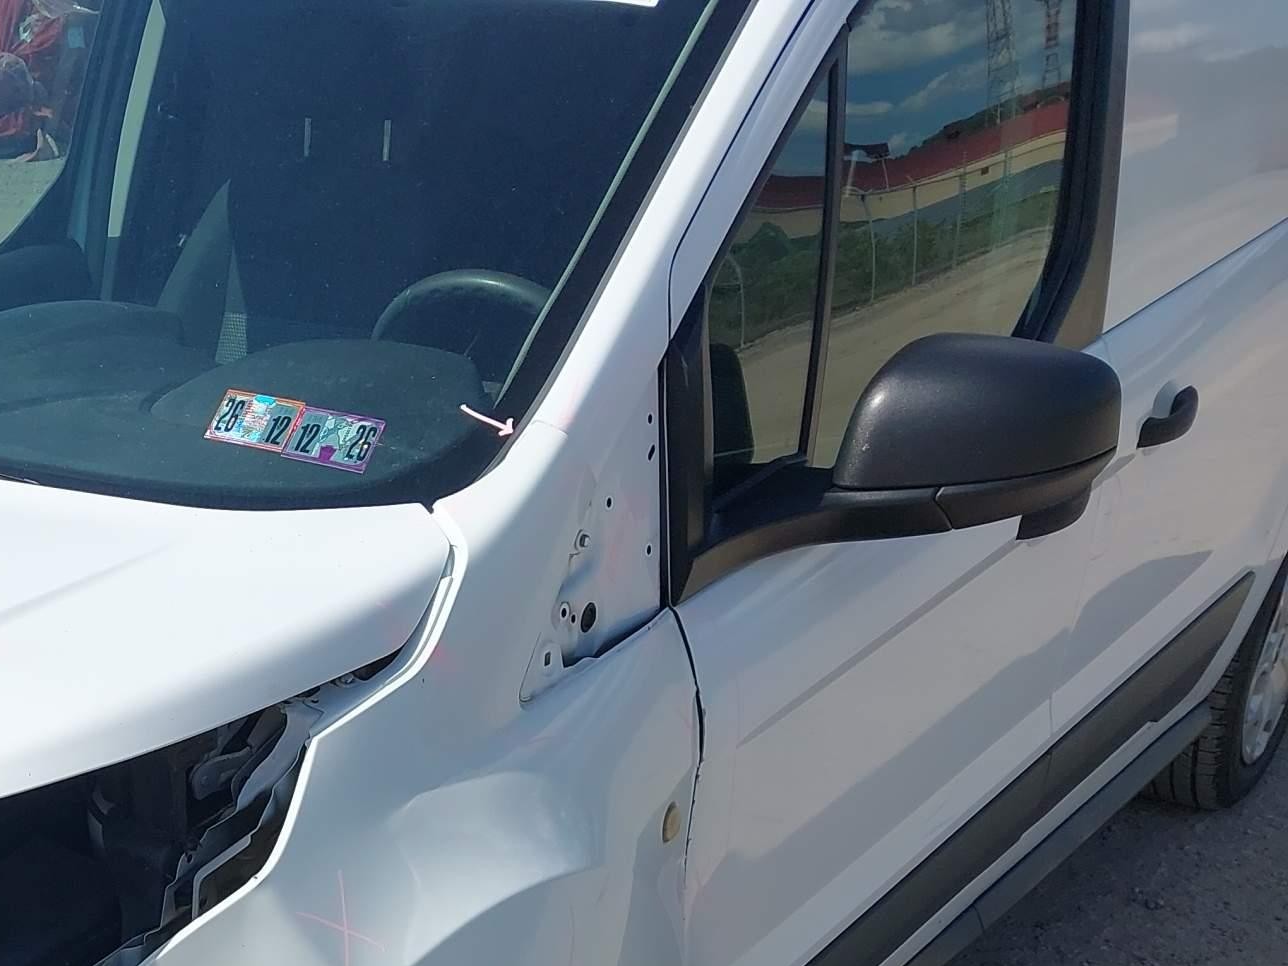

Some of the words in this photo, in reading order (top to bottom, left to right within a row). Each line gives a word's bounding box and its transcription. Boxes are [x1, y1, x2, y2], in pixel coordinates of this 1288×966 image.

[214, 397, 246, 433] 26
[264, 415, 292, 446] 12
[294, 423, 321, 454] 12
[346, 424, 378, 462] 26
